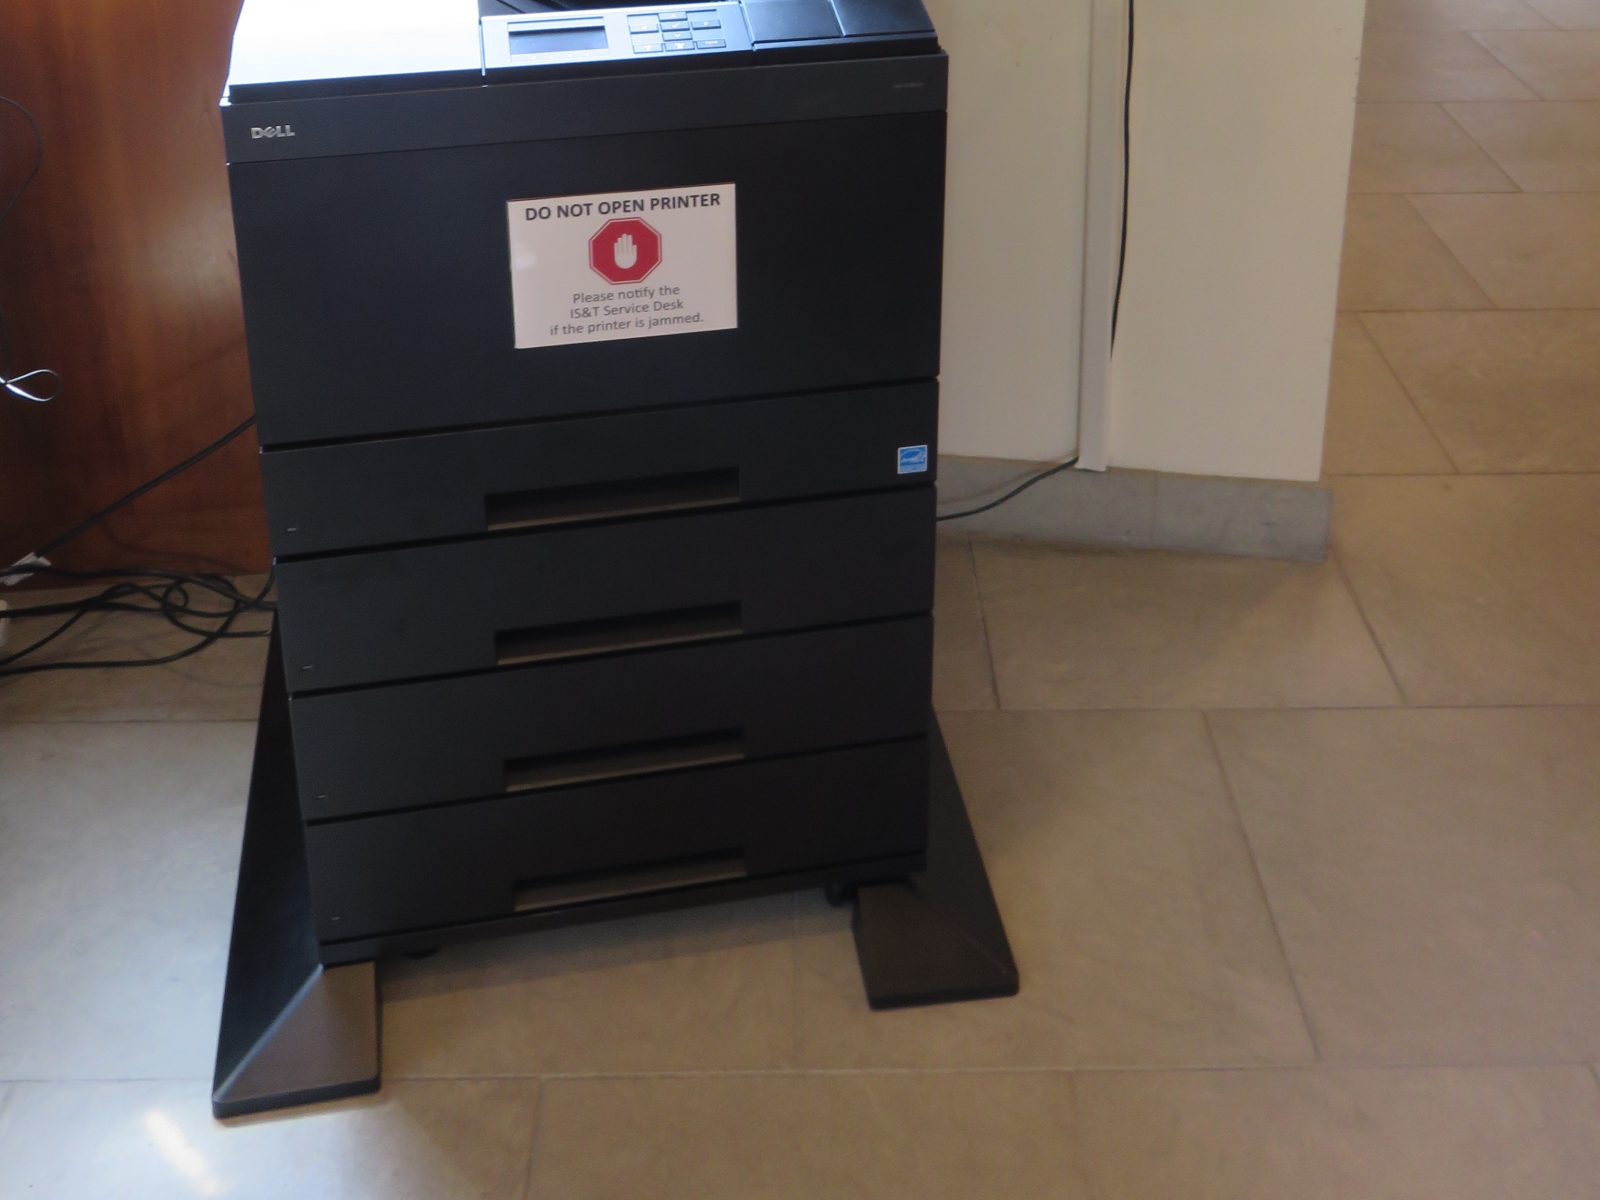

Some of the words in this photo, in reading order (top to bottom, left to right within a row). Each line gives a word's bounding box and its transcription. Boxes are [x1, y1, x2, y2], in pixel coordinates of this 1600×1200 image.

[251, 124, 295, 139] DELL
[525, 206, 551, 220] DO
[557, 203, 592, 218] NOT
[598, 200, 645, 214] OPEN
[650, 193, 720, 210] PRINTER
[573, 292, 614, 304] Please
[618, 287, 655, 300] notify
[659, 285, 680, 296] the
[570, 306, 600, 318] IS&T
[604, 303, 649, 316] Service
[653, 300, 684, 311] Desk
[550, 325, 560, 336] if
[563, 323, 584, 335] the
[588, 319, 630, 334] printer
[635, 317, 645, 328] is
[648, 313, 704, 329] jammed.
